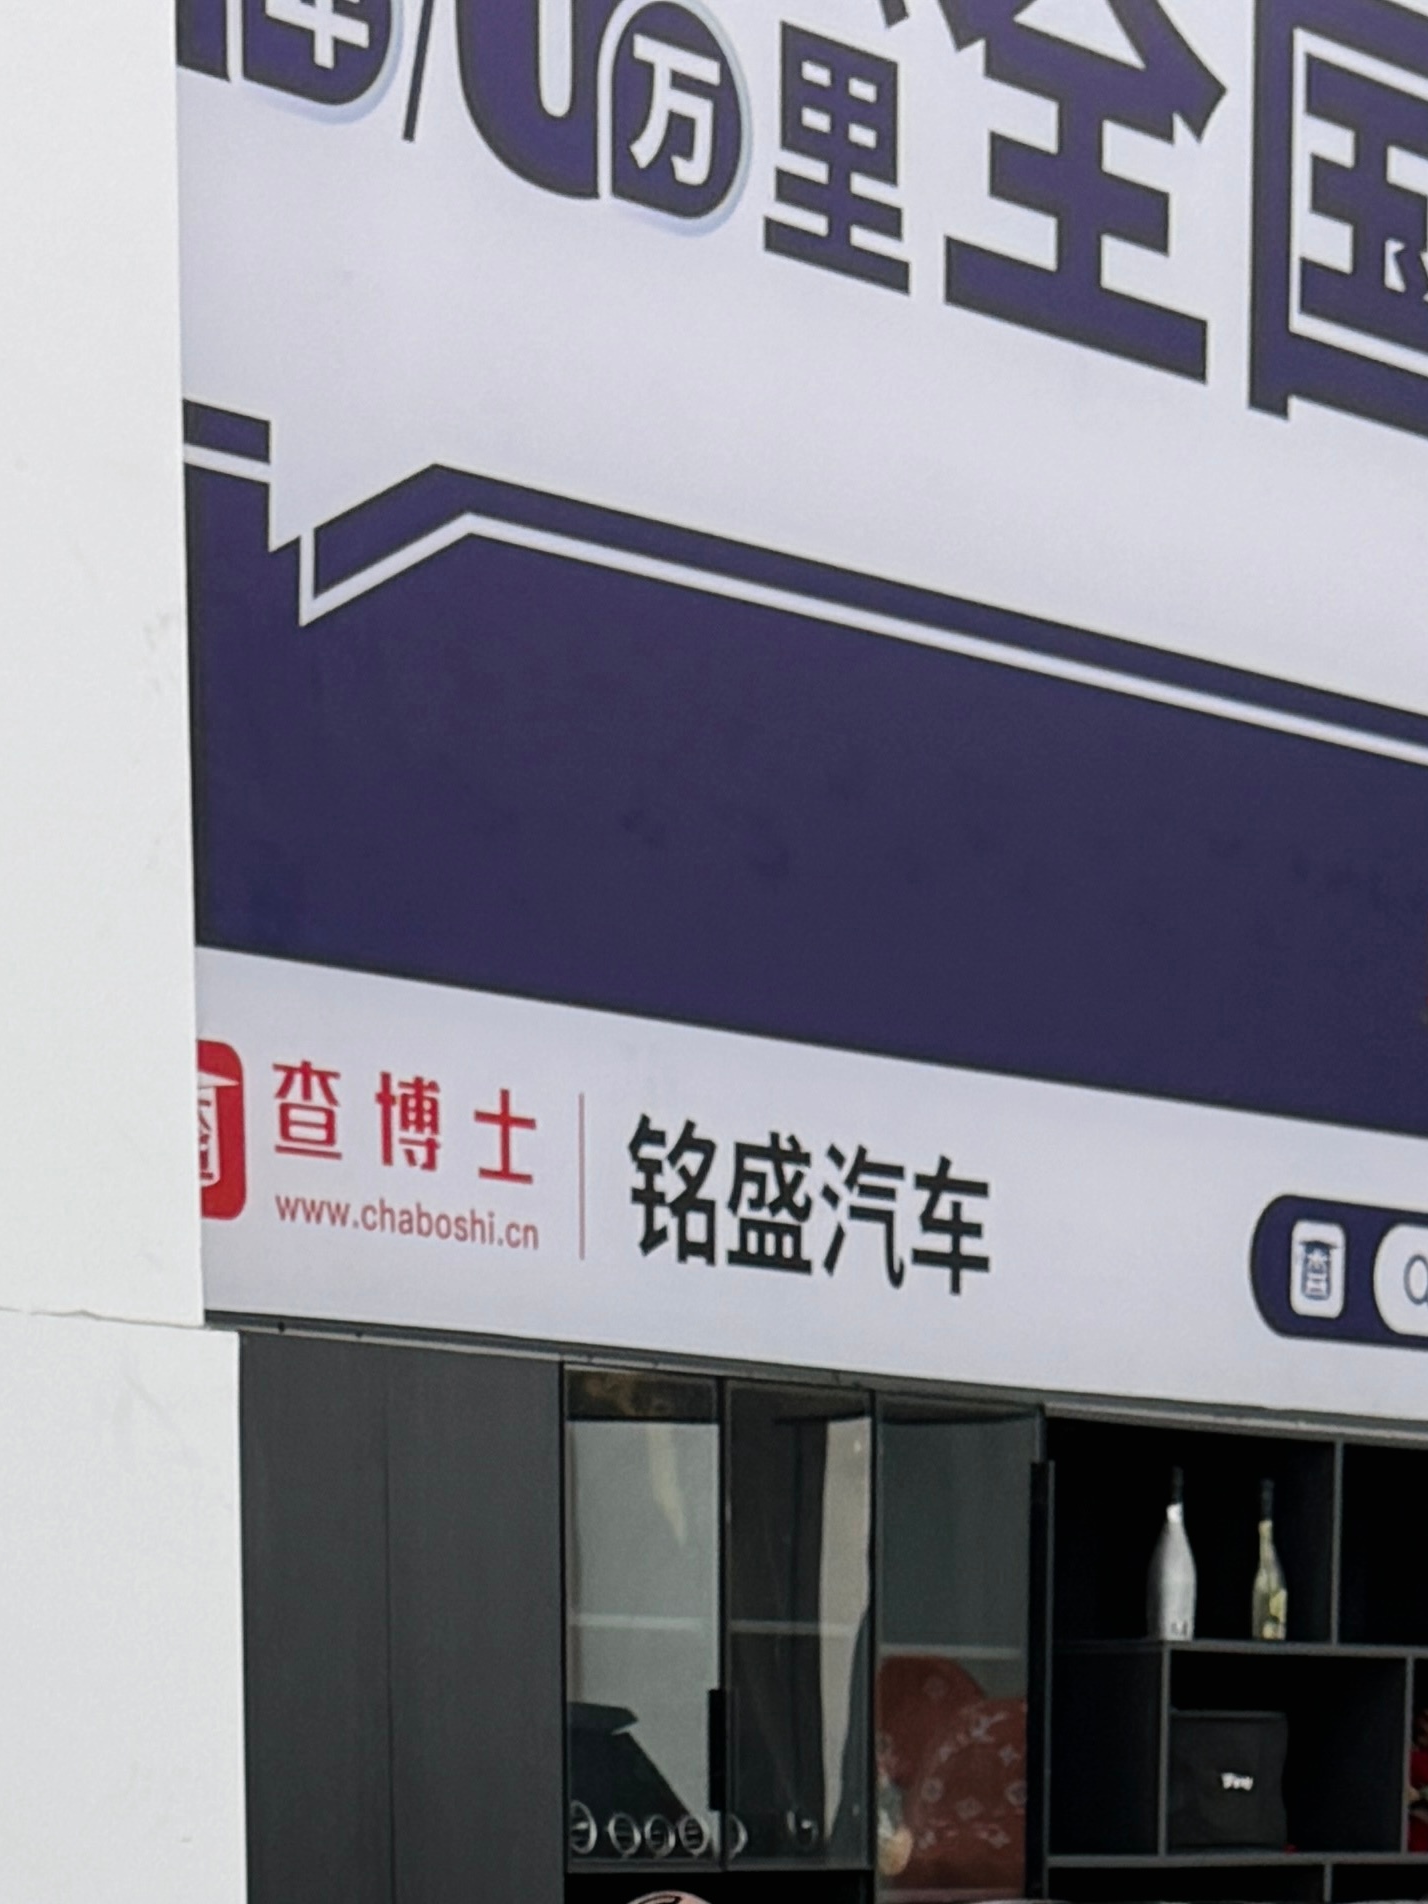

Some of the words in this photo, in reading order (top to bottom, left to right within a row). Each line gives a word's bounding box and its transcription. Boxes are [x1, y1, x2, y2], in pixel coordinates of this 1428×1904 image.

[271, 1059, 536, 1185] 查博士
[274, 1192, 540, 1251] www.chaboshi.cn
[627, 1113, 991, 1296] 铭盛汽车
